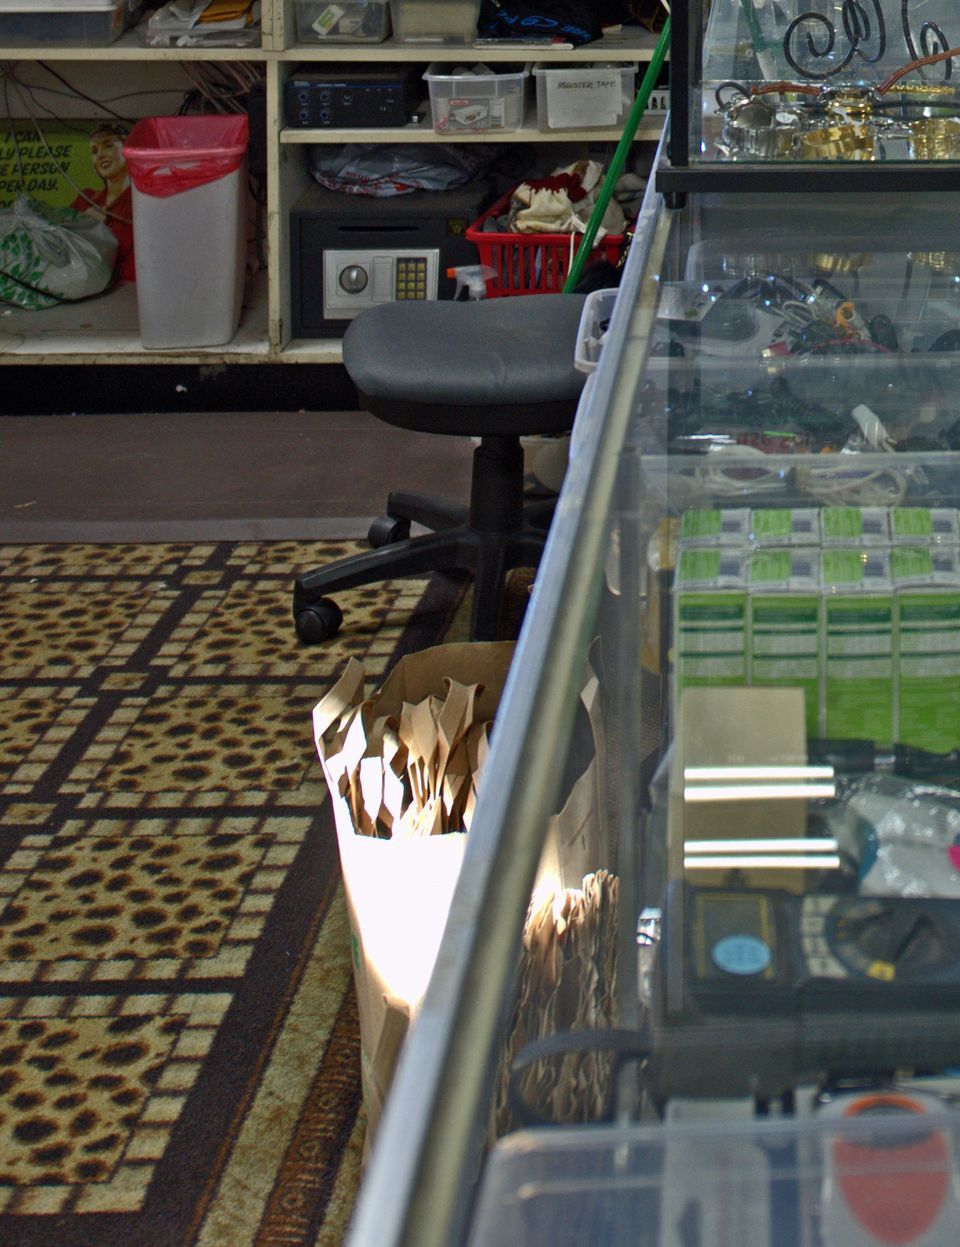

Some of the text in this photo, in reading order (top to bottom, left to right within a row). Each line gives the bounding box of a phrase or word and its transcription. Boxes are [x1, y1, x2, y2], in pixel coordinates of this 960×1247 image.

[558, 80, 617, 89] REGISTER TAPE
[15, 130, 44, 144] CAN
[20, 145, 72, 159] PLEASE
[11, 161, 70, 176] PERSON
